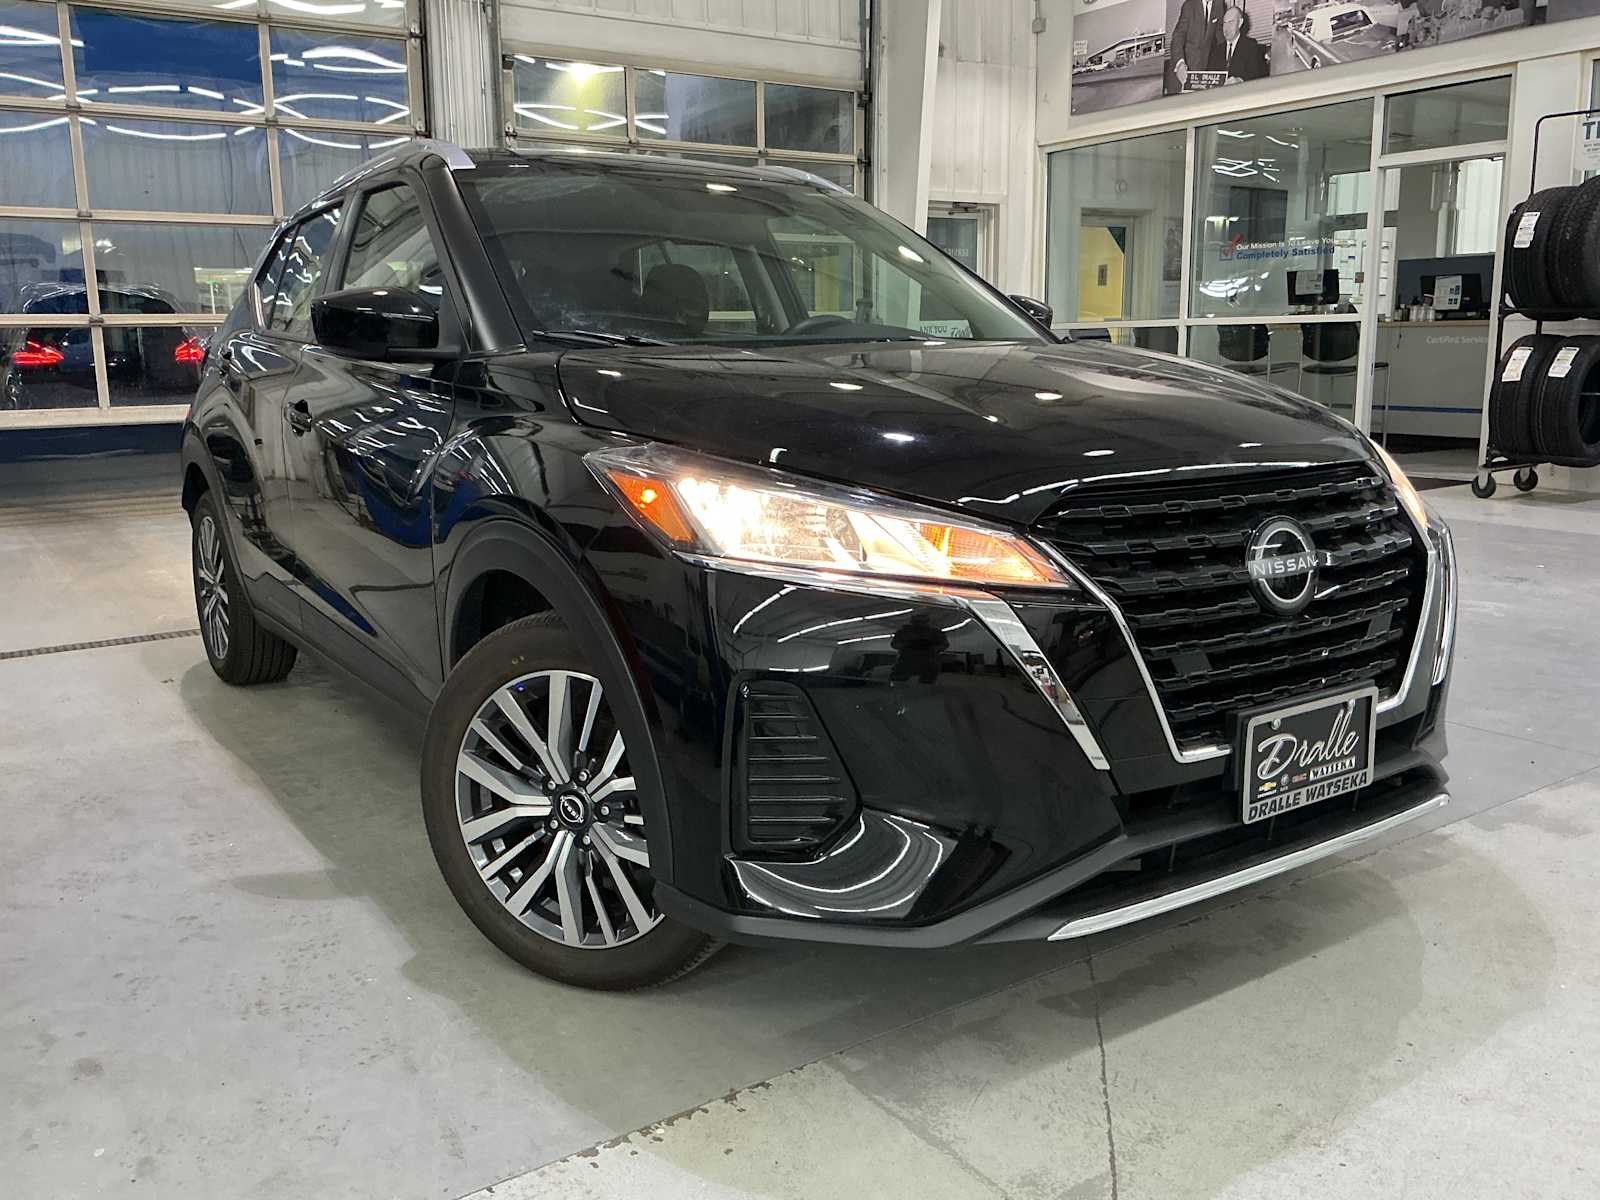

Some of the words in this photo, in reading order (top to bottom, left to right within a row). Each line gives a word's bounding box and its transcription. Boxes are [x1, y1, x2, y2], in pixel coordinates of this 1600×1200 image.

[1236, 243, 1250, 251] Our
[1251, 241, 1278, 250] Mission
[1236, 248, 1289, 260] Completely
[1291, 244, 1335, 257] Satisfied
[1252, 555, 1317, 577] NISSAN
[1257, 706, 1360, 780] Dralle
[1312, 758, 1354, 778] WATSEKA
[1248, 791, 1300, 821] DRALLE
[1305, 770, 1368, 803] WATSEKA
